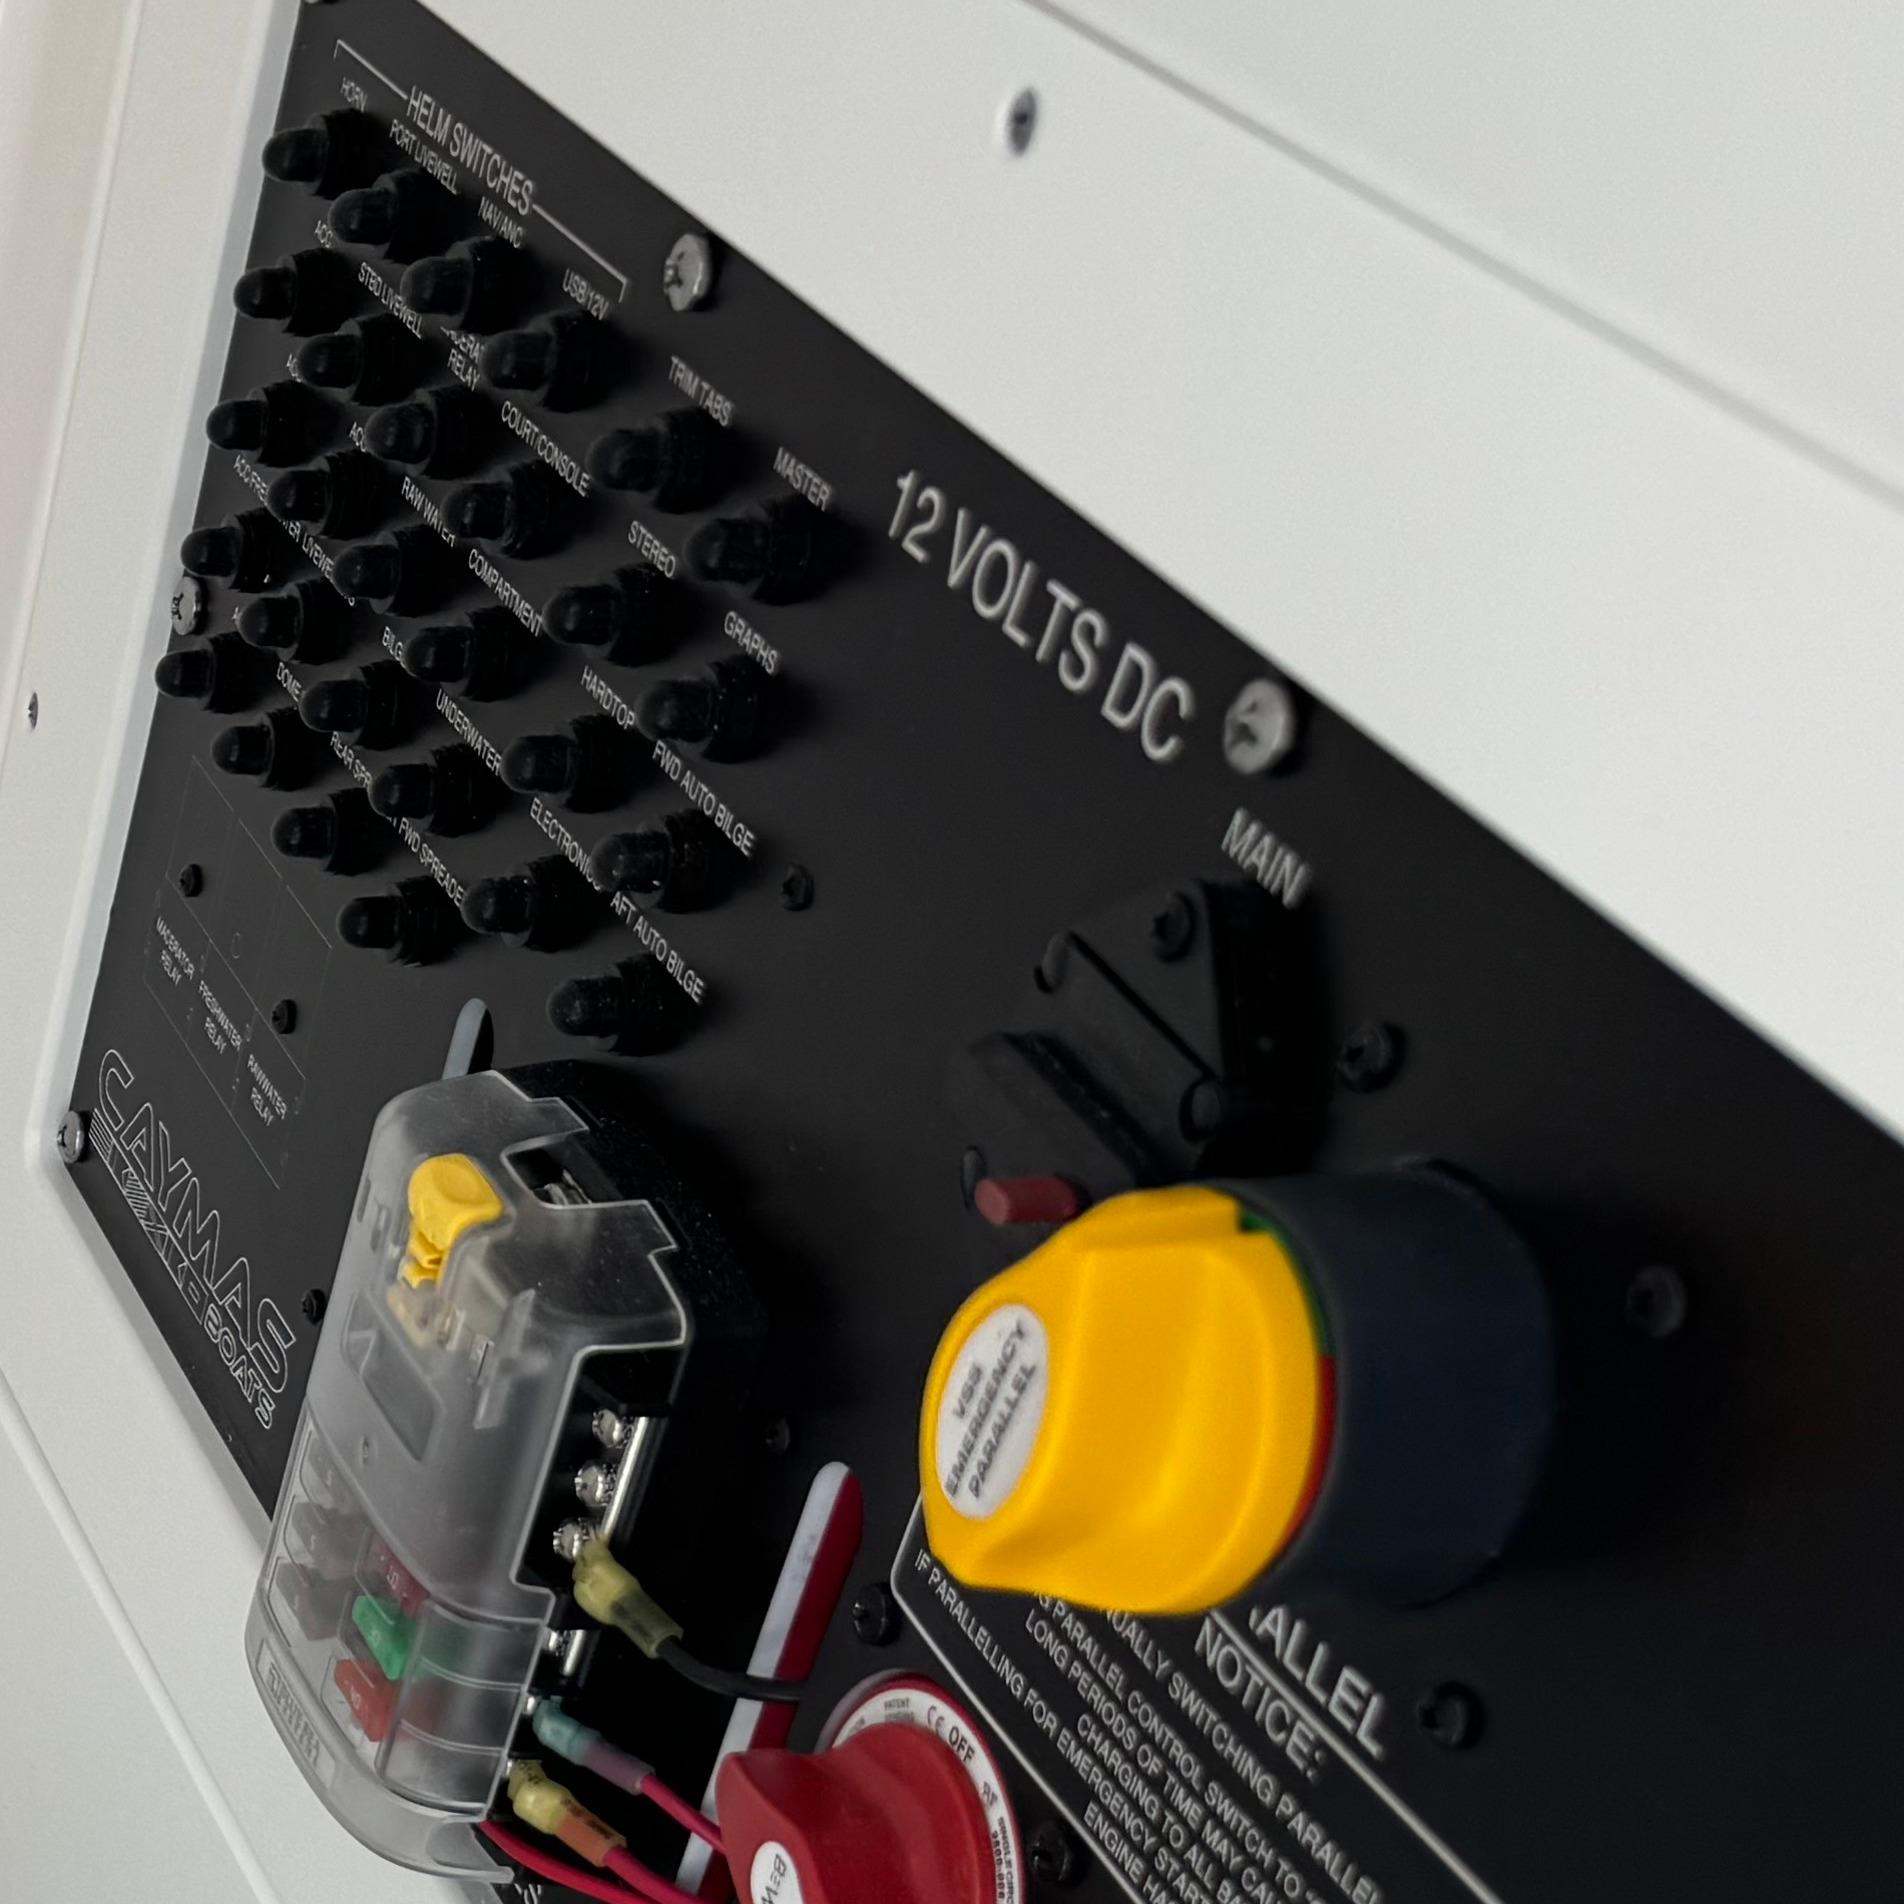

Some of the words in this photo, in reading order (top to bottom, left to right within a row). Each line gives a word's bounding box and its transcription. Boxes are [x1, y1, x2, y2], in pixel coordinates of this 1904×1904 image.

[340, 77, 367, 112] HORN
[389, 119, 416, 158] PORT
[414, 143, 459, 195] LIVEWELL
[406, 86, 452, 146] HELM
[450, 122, 533, 216] SWITCHES
[381, 288, 423, 339] LIVEWELL
[562, 268, 609, 320] USB/12V
[668, 355, 700, 397] TRIM
[698, 380, 735, 427] TABS
[773, 447, 833, 511] MASTER
[468, 548, 543, 637] COMPARTMENT
[627, 519, 677, 579] STEREO
[723, 610, 781, 675] GRAPHS
[888, 469, 946, 563] 12
[947, 506, 1109, 693] VOLTS
[1101, 640, 1194, 763] DC
[435, 688, 502, 776] UNDERWATER
[581, 665, 636, 731] HARDTOP
[398, 817, 421, 853] FWD
[652, 740, 683, 781] FWD
[679, 769, 717, 816] AUTO
[713, 804, 757, 857] BILGE
[1221, 806, 1313, 909] MAIN
[610, 891, 636, 925] AFT
[633, 915, 669, 962] AUTO
[665, 949, 705, 1004] BILGE
[99, 1048, 296, 1393] CAYMAS
[203, 1304, 276, 1430] BOATS
[945, 1320, 1028, 1499] EMERGENCY
[967, 1361, 1038, 1498] PARALLEL
[914, 1549, 932, 1573] IF
[1022, 1686, 1060, 1742] FOR
[1056, 1727, 1158, 1855] EMERGENCY
[1195, 1616, 1326, 1783] NOTICE:
[1248, 1602, 1386, 1762] ALLEL
[948, 1725, 976, 1764] OFF
[1024, 1608, 1068, 1672] LONG
[1067, 1655, 1142, 1752] PERIODS
[1135, 1741, 1167, 1788] OF
[1164, 1770, 1206, 1830] TIME
[1201, 1816, 1243, 1879] MAY
[1052, 1599, 1127, 1698] PARALLEL
[1126, 1688, 1208, 1793] CONTROL
[1203, 1780, 1275, 1868] SWITCH
[1274, 1854, 1304, 1898] TO
[1167, 1669, 1279, 1804] SWITCHING
[1077, 1712, 1163, 1822] CHARGING
[1161, 1808, 1189, 1852] TO
[1185, 1837, 1220, 1893] ALL
[1082, 1802, 1147, 1886] ENGINE
